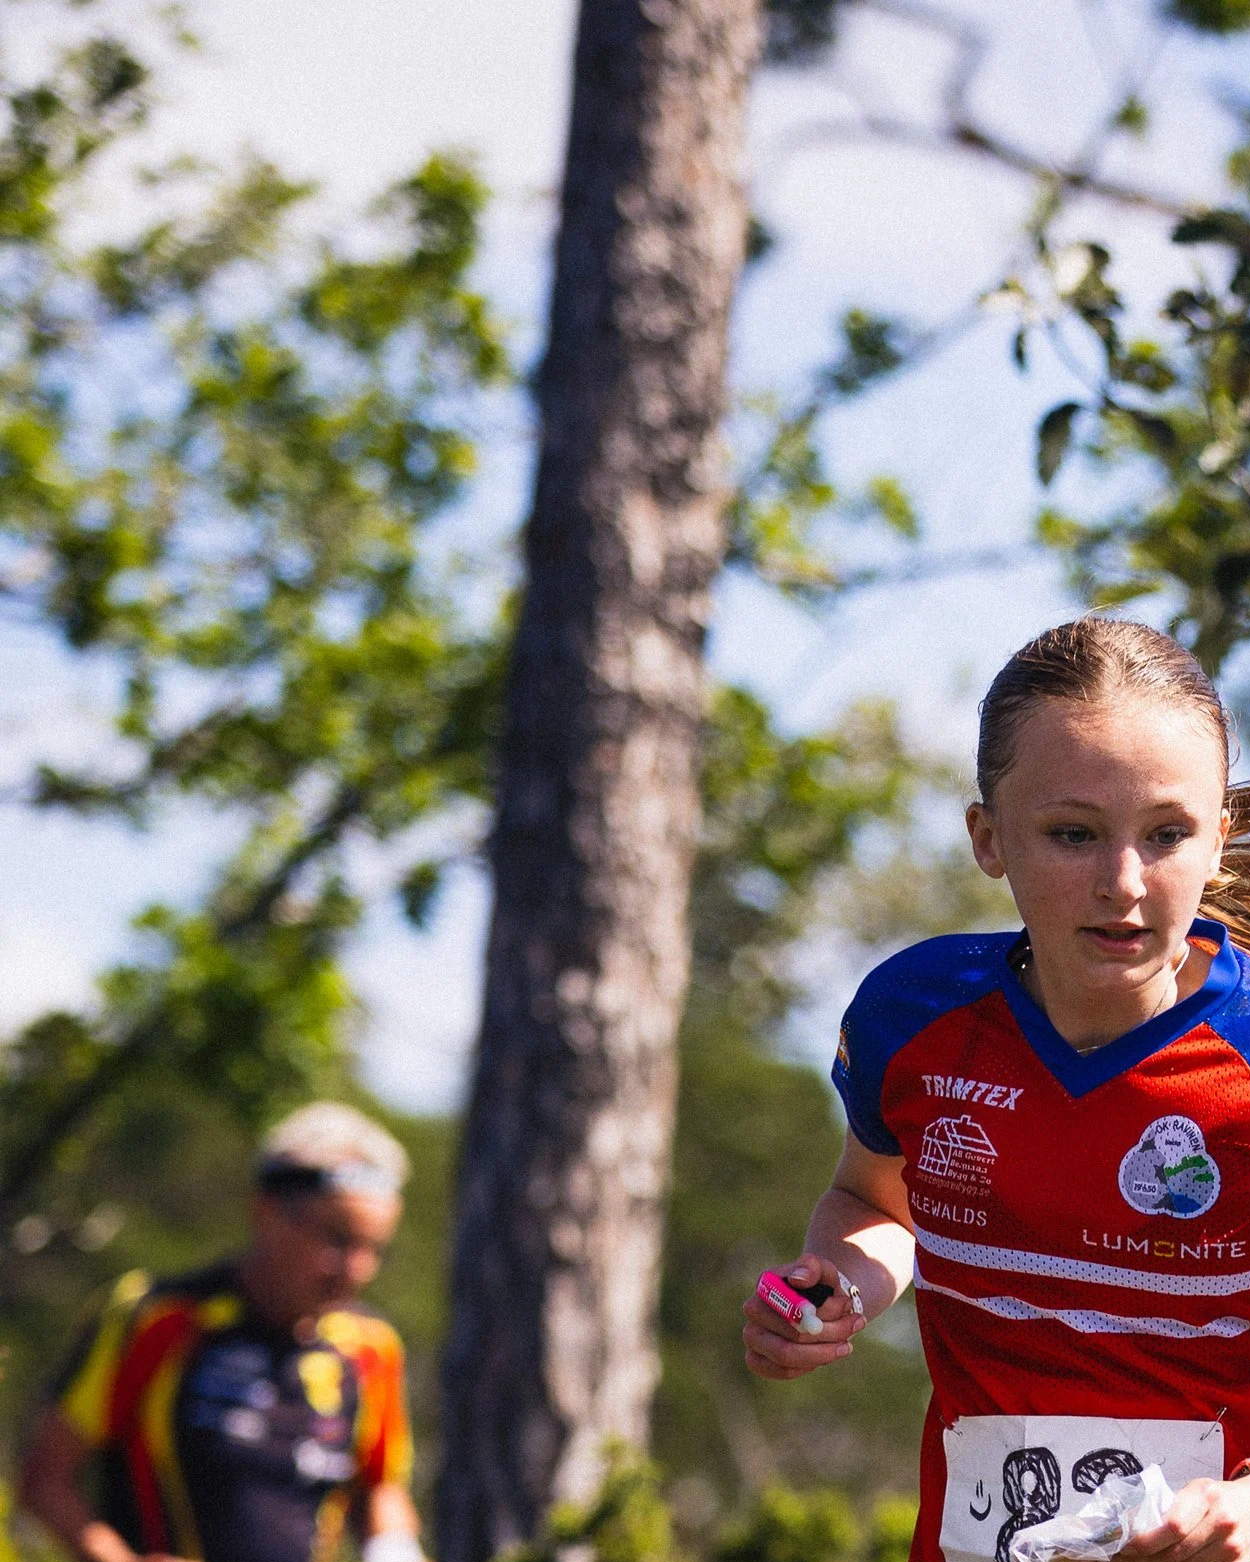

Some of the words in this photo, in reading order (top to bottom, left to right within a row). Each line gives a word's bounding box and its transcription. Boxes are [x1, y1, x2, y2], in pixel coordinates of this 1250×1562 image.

[921, 1074, 1024, 1110] TRIMTEX
[1155, 1121, 1169, 1134] OK
[1172, 1119, 1201, 1152] RAVINEN
[911, 1191, 987, 1227] ALEWALDS
[1082, 1229, 1247, 1260] LUMONITE
